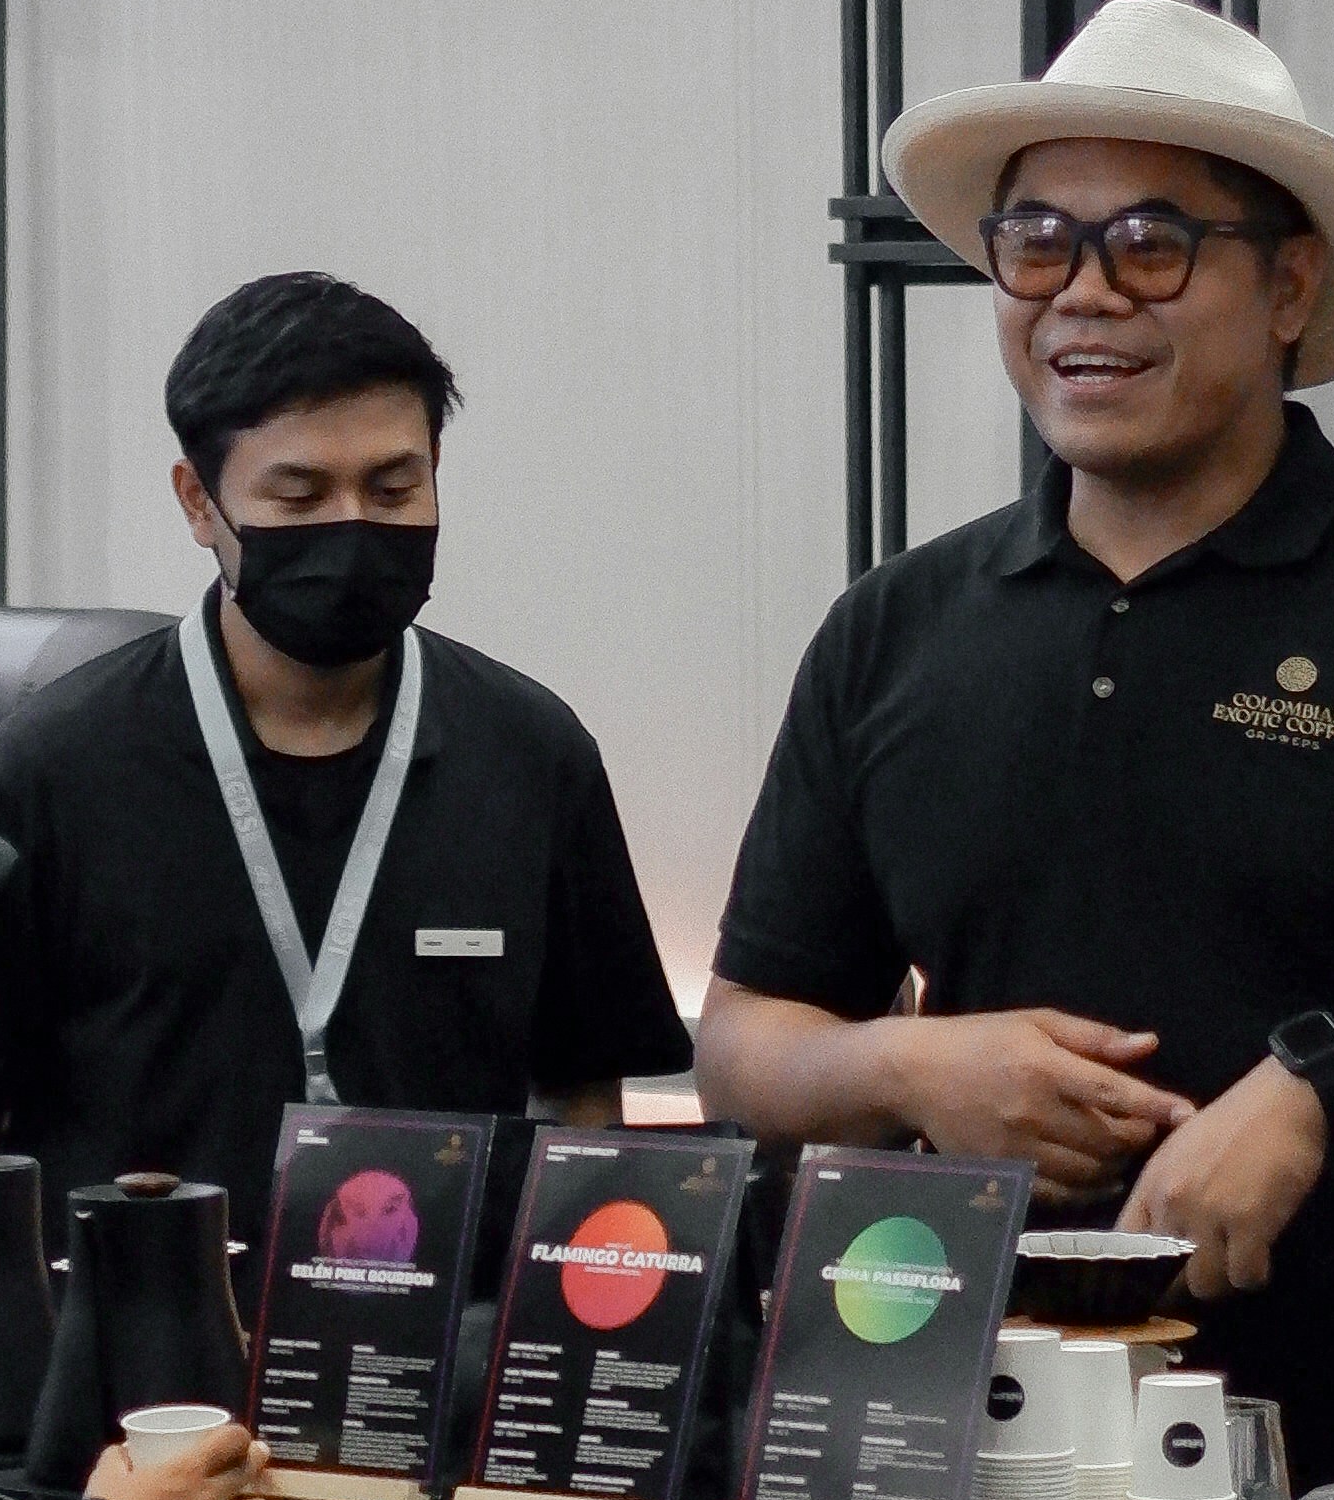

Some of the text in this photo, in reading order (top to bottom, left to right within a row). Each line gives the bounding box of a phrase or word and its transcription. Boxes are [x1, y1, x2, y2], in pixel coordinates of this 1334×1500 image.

[1212, 702, 1283, 729] EXOTIC
[530, 1243, 620, 1266] FLAMINGO
[622, 1251, 704, 1274] CATURRA
